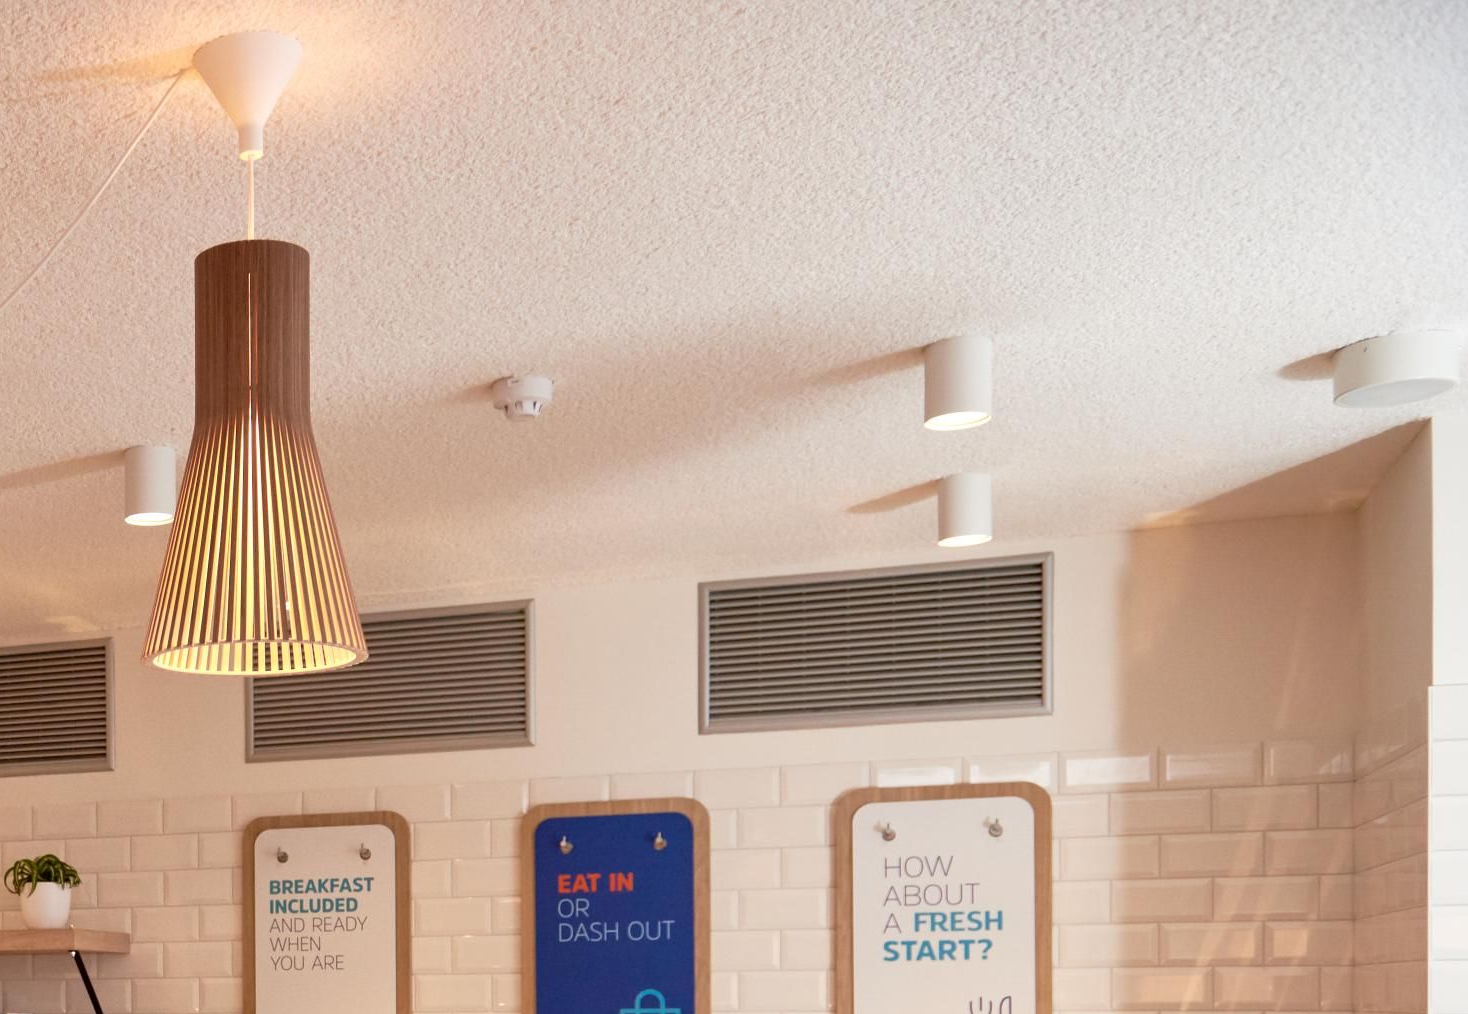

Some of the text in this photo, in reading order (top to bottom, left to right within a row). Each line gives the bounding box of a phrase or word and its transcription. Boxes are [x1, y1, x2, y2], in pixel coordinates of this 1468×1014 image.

[884, 855, 954, 878] HOW
[269, 877, 374, 895] BREAKFAST
[557, 872, 634, 893] EAT IN
[883, 883, 981, 907] ABOUT
[269, 897, 358, 914] INCLUDED
[557, 898, 590, 918] OR
[269, 916, 368, 933] AND READY
[558, 920, 676, 942] DASH OUT
[883, 910, 1004, 934] A FRESH
[270, 936, 321, 952] WHEN
[883, 939, 992, 962] START?
[270, 955, 345, 971] YOU ARE
